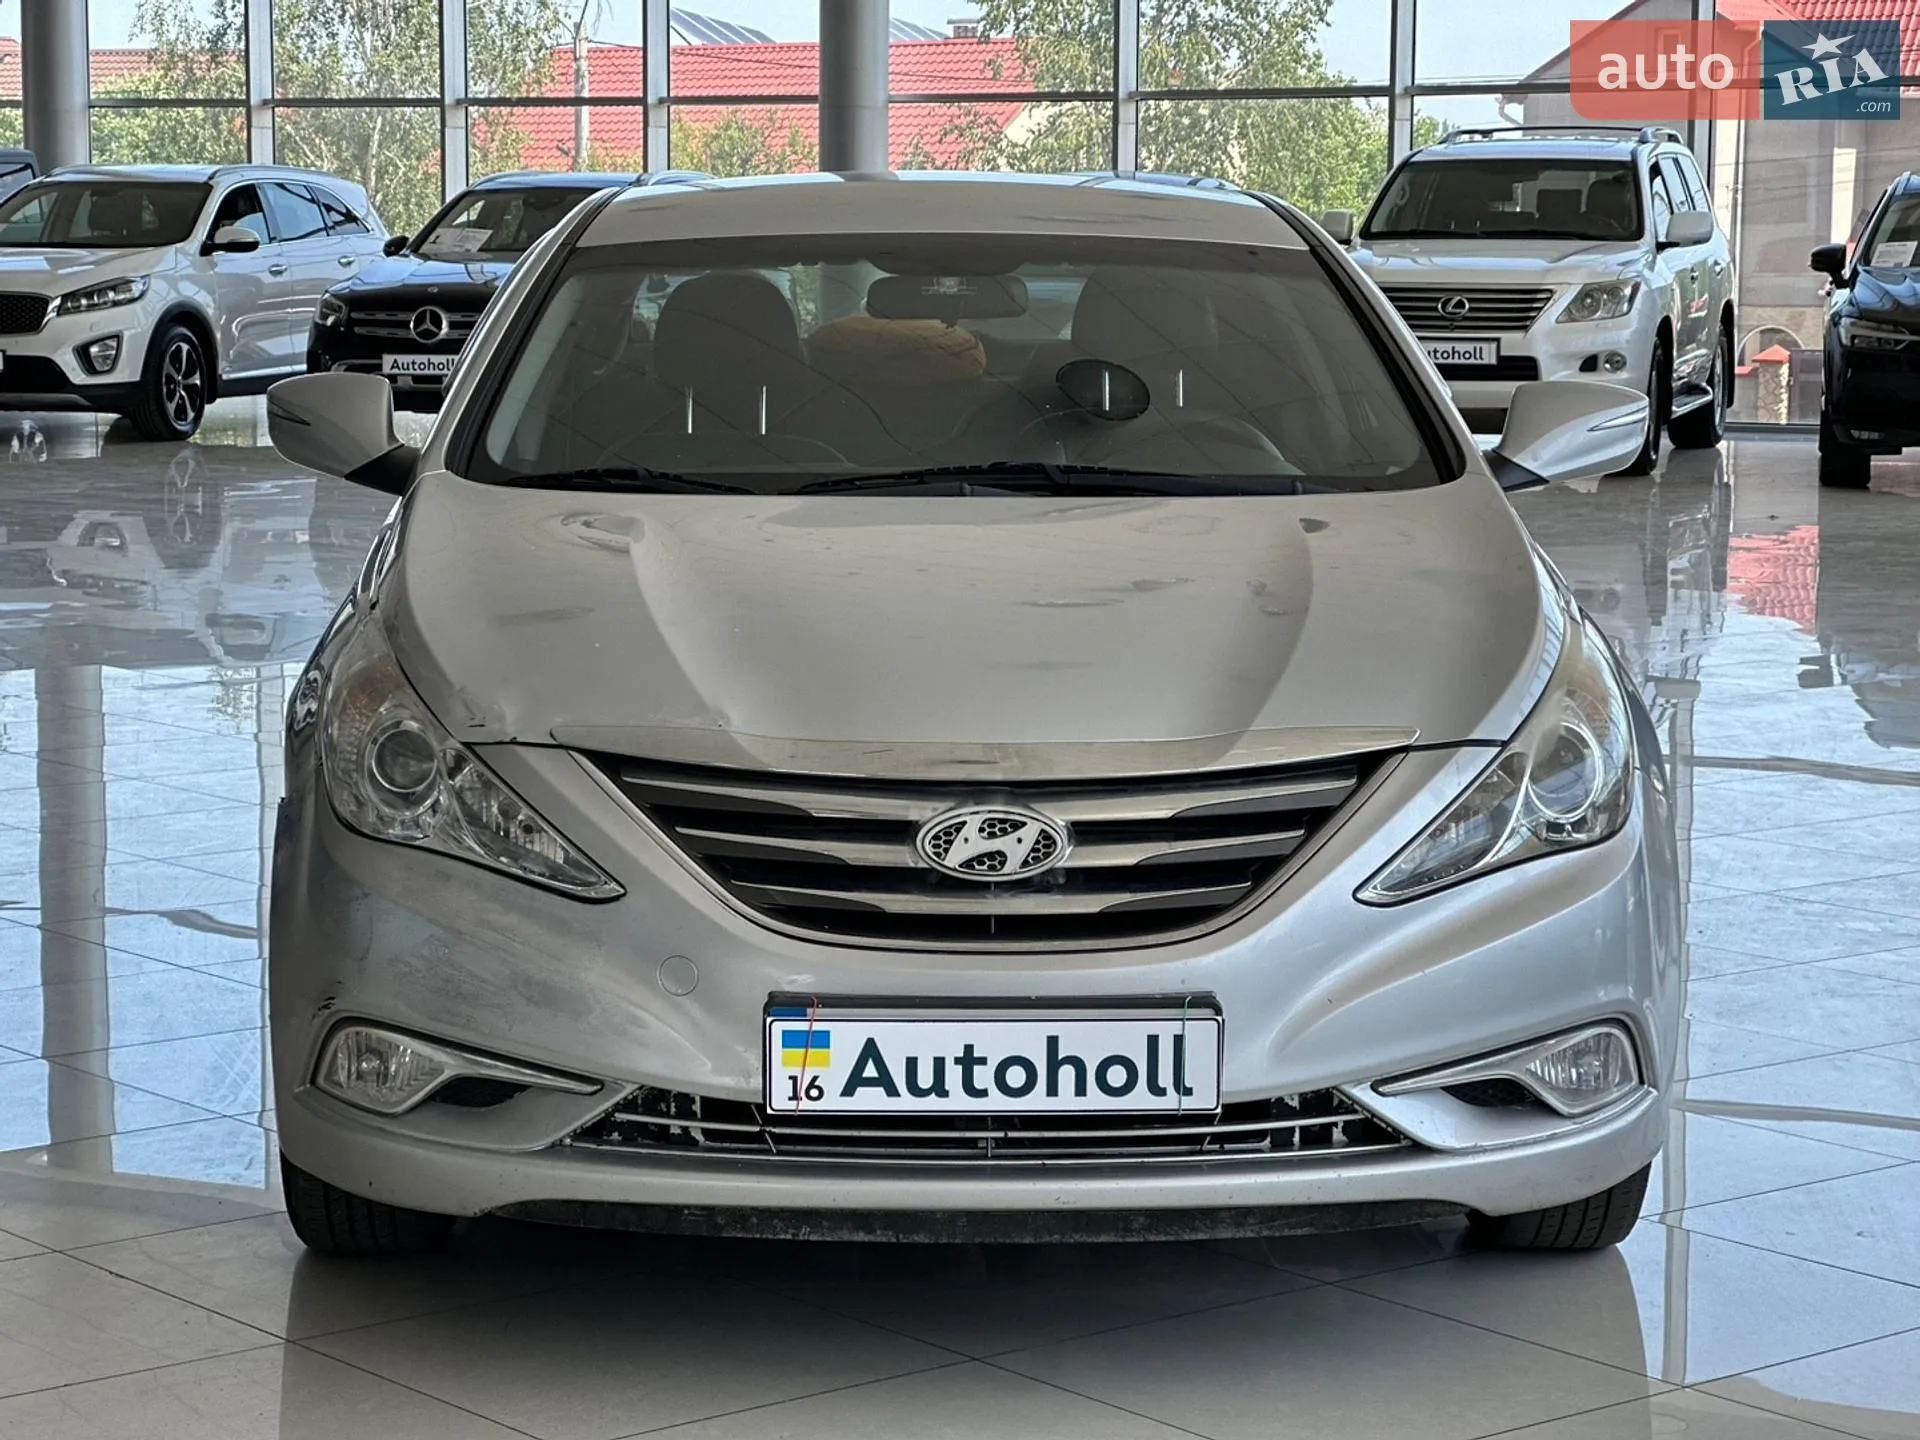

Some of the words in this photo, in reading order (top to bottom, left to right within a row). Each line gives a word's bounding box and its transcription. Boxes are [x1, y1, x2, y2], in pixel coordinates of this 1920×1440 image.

[1427, 345, 1484, 361] toholl
[839, 1034, 1194, 1098] Autoholl
[787, 1074, 825, 1102] 16
